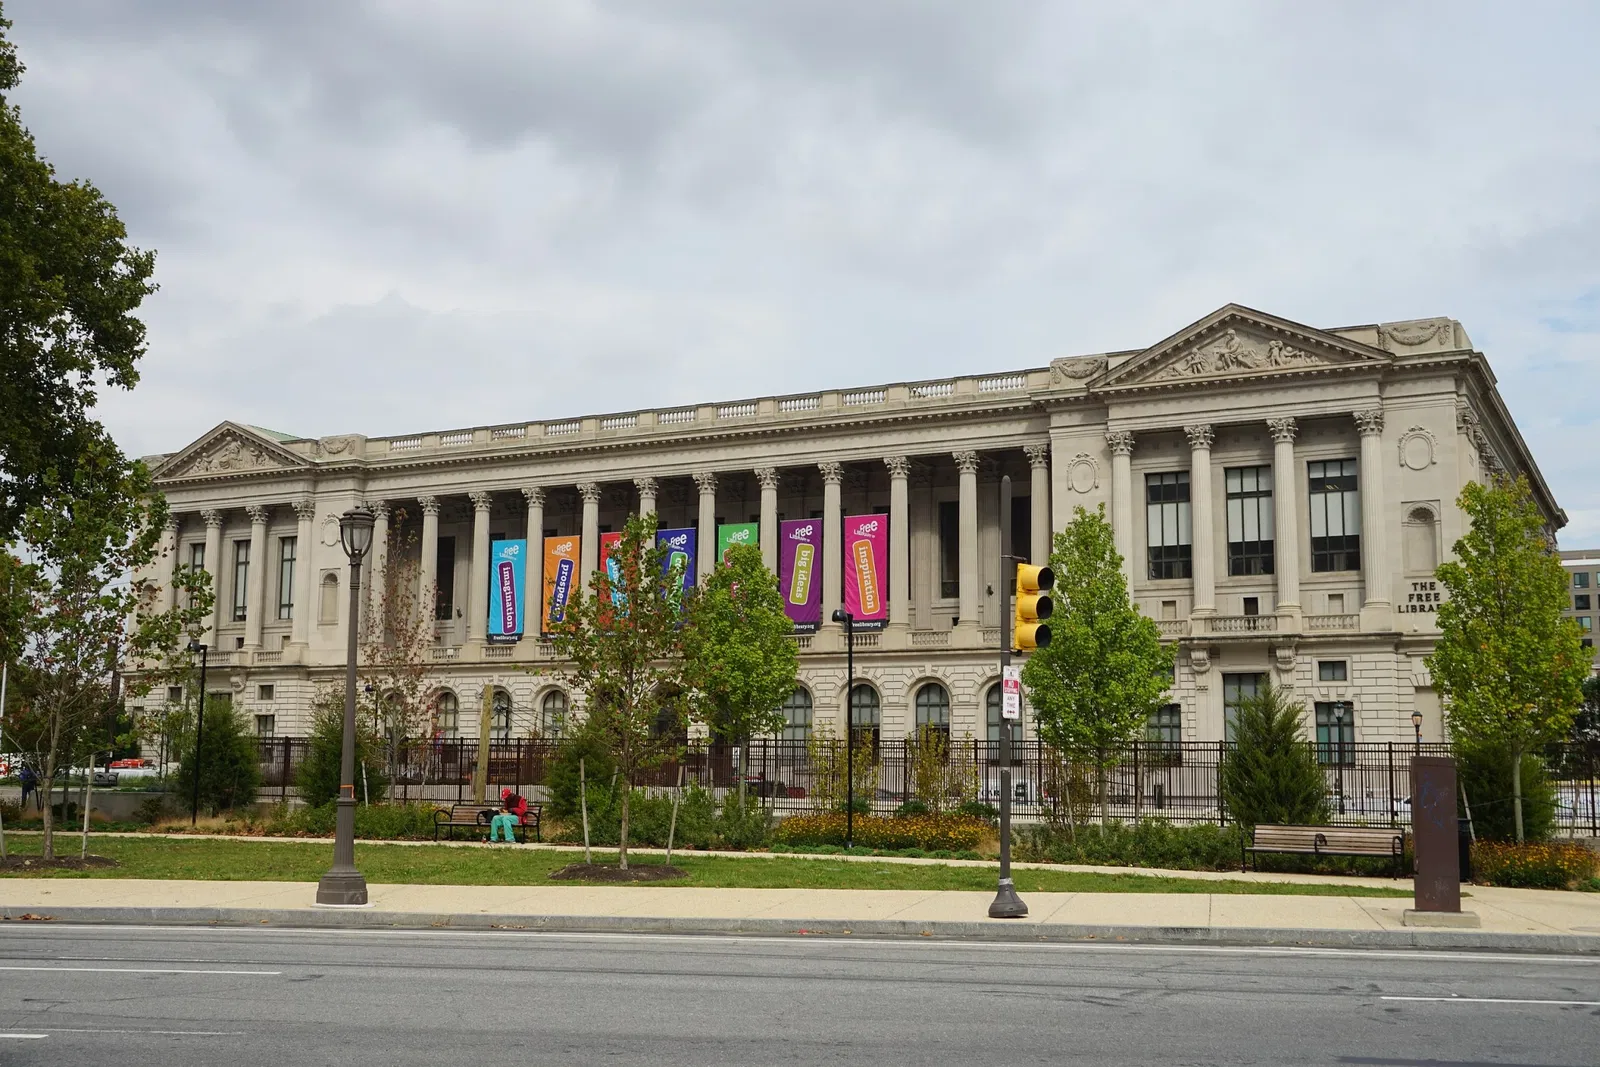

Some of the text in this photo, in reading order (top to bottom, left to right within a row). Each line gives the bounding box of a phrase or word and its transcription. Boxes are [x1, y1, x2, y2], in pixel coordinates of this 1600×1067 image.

[796, 550, 810, 598] big ideas
[858, 546, 874, 609] inspiration
[1412, 582, 1436, 592] THE
[502, 566, 514, 628] imagination
[1398, 604, 1442, 614] LIBRA
[1408, 592, 1440, 602] FREE
